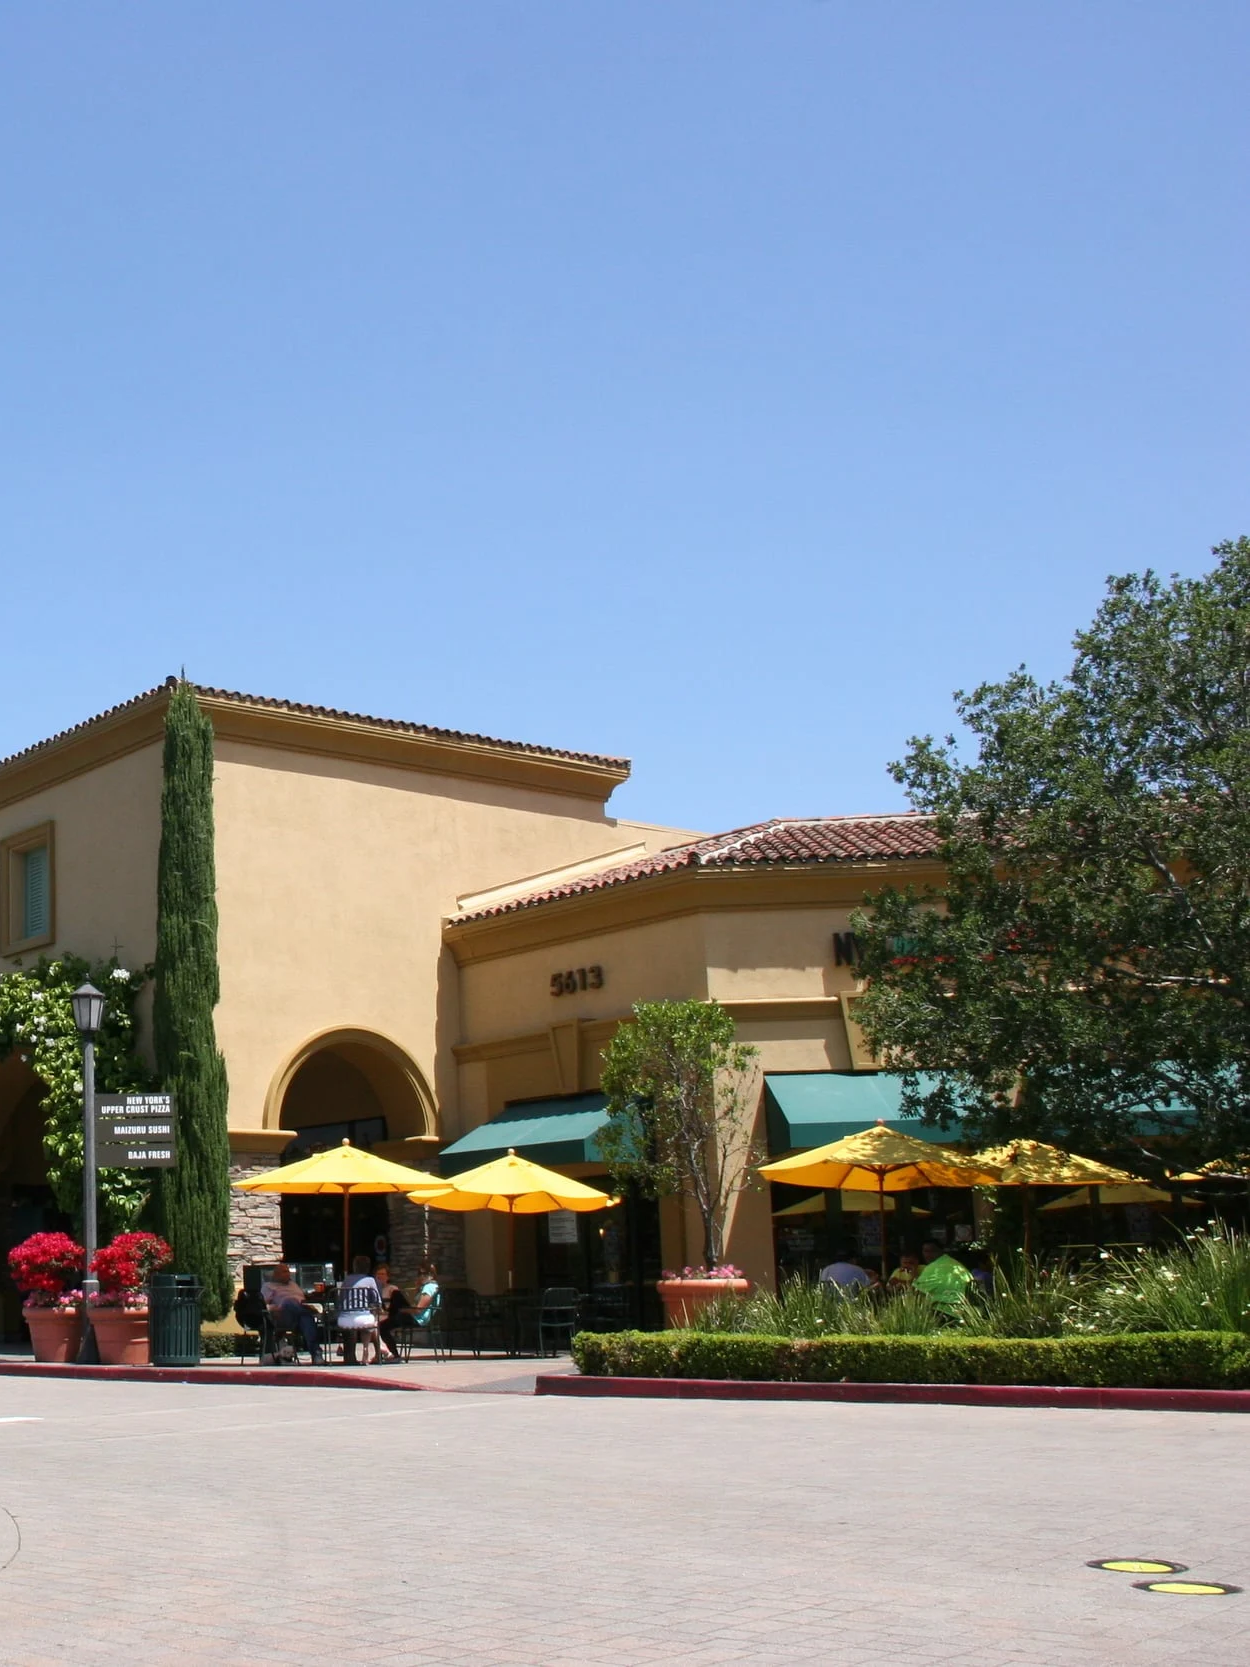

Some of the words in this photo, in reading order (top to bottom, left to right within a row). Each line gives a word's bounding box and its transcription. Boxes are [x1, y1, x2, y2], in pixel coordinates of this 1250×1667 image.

[550, 965, 603, 997] 5613
[126, 1096, 143, 1105] NEW
[144, 1095, 170, 1104] YORK'S
[101, 1105, 124, 1114] UPPER
[125, 1105, 149, 1114] CRUST
[150, 1104, 171, 1113] PIZZA
[113, 1126, 147, 1135] MAIZURU
[148, 1125, 170, 1134] SUSHI
[127, 1151, 147, 1160] BAJA
[148, 1150, 171, 1159] FRESH
